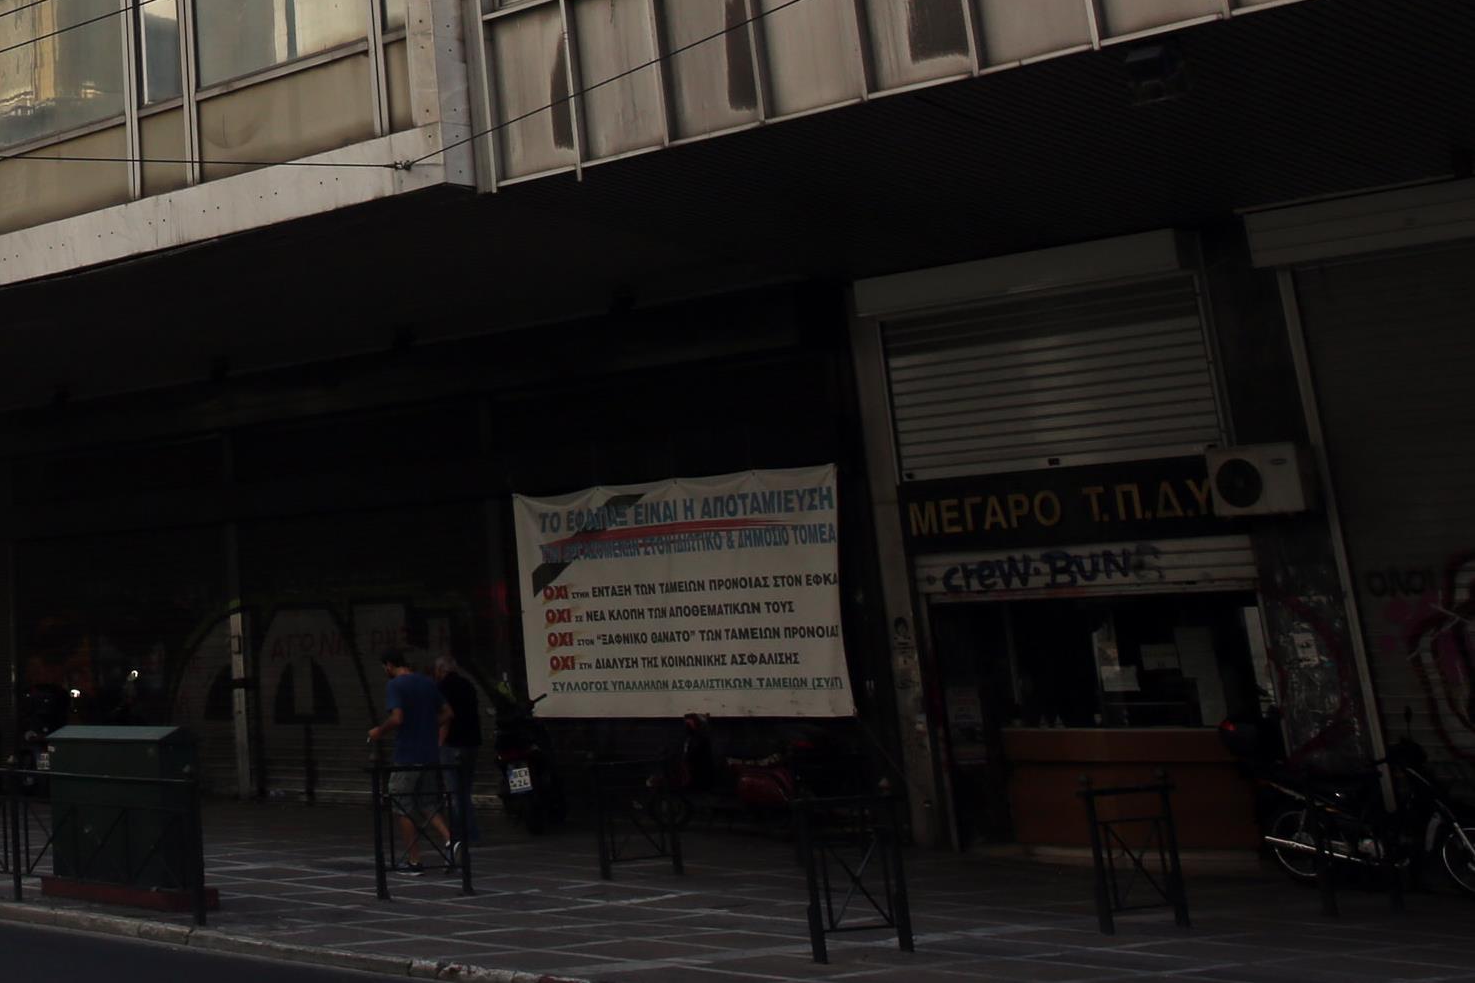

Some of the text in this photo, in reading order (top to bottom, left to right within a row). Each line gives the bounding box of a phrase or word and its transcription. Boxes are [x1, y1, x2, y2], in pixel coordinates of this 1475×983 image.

[540, 512, 561, 533] ΤΟ
[634, 499, 678, 525] ΕΙΝΑΙ
[683, 498, 694, 519] Η
[701, 486, 834, 519] ΑΠΟΤΑΜΙΕΥΣΗ
[909, 489, 1063, 537] ΜΕΓΑΡΟ
[727, 529, 735, 550] &
[738, 525, 790, 548] ΔΗΜΟΣΙΟ
[792, 523, 837, 545] ΤΟΜΕΑ
[543, 584, 568, 599] ΟΧΙ
[592, 584, 631, 598] ΕΝΤΑΞΗ
[634, 583, 656, 596] ΤΩΝ
[659, 580, 705, 595] ΤΑΜΕΙΩΝ
[710, 576, 770, 591] ΠΡΟΝΟΙΑΣ
[773, 574, 803, 588] ΣΤΟΝ
[806, 572, 839, 587] ΕΦΚΑ
[546, 608, 572, 623] ΟΧΙ
[586, 610, 606, 622] ΝΕΑ
[609, 608, 645, 621] ΚΛΟΠΗ
[647, 607, 667, 619] ΤΩΝ
[669, 602, 761, 618] ΑΠΟΘΕΜΑΤΙΚΩΝ
[765, 601, 795, 613] ΤΟΥΣ
[548, 632, 574, 647] ΟΧΙ
[699, 628, 722, 642] ΤΩΝ
[724, 626, 780, 641] ΤΑΜΕΙΩΝ
[550, 656, 575, 670] ΟΧΙ
[595, 658, 639, 670] ΔΙΑΛΥΣΗ
[641, 657, 659, 669] ΤΗΣ
[661, 654, 727, 668] ΚΟΙΝΩΝΙΚΗΣ
[730, 652, 800, 666] ΑΣΦΑΛΙΣΗΣ
[552, 681, 609, 691] ΣΥΛΛΟΓΟΣ
[611, 680, 669, 691] ΥΠΑΛΛΗΛΩΝ
[671, 677, 752, 690] ΑΣΦΑΛΙΣΤΙΚΩΝ
[756, 677, 808, 689] ΤΑΜΕΙΩΝ
